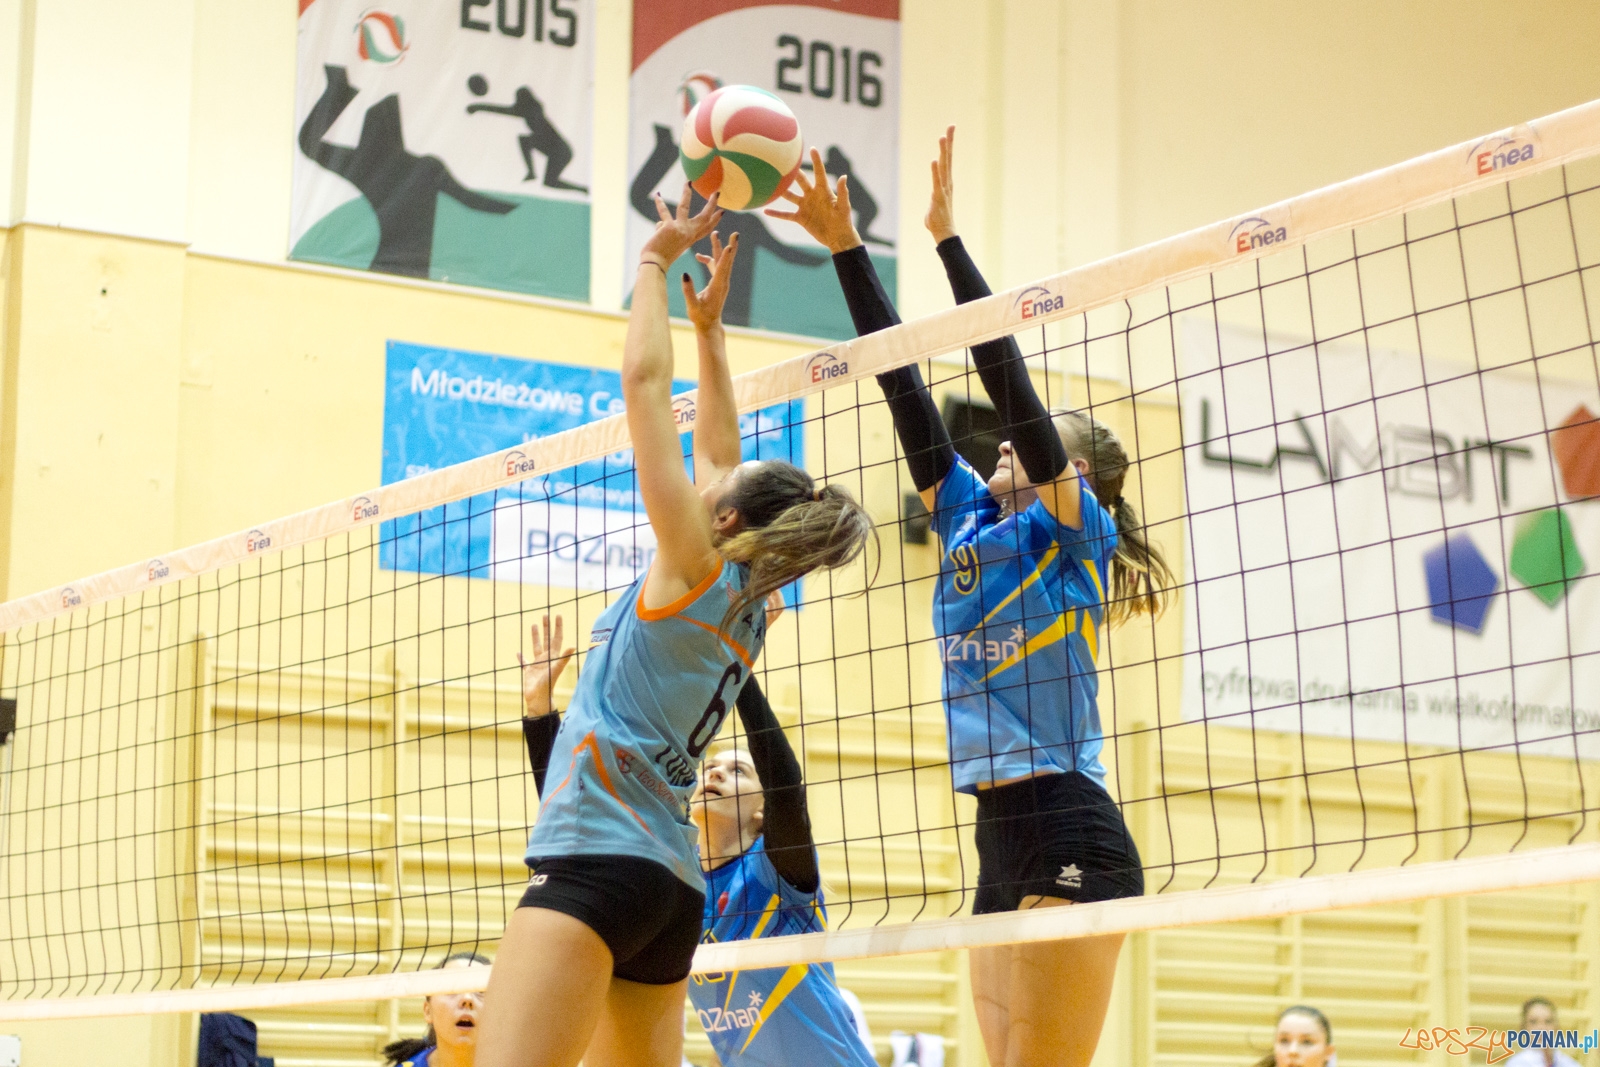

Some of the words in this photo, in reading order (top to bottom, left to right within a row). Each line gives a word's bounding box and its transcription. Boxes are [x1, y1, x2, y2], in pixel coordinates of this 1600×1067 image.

[461, 0, 577, 47] 2015
[776, 34, 884, 108] 2016
[1477, 143, 1535, 176] Enea
[1237, 226, 1287, 253] Enea
[1021, 294, 1064, 320] Enea
[811, 361, 849, 384] Enea
[410, 366, 584, 416] Młodzieżowe
[672, 408, 697, 425] Ene
[1201, 397, 1534, 509] LAMBIT
[507, 459, 536, 477] Enea
[353, 505, 379, 522] Enea
[247, 536, 271, 553] Enea
[148, 566, 169, 582] Enea
[63, 593, 81, 609] Enea
[1200, 667, 1297, 701] cyfrowa
[687, 661, 742, 758] 6
